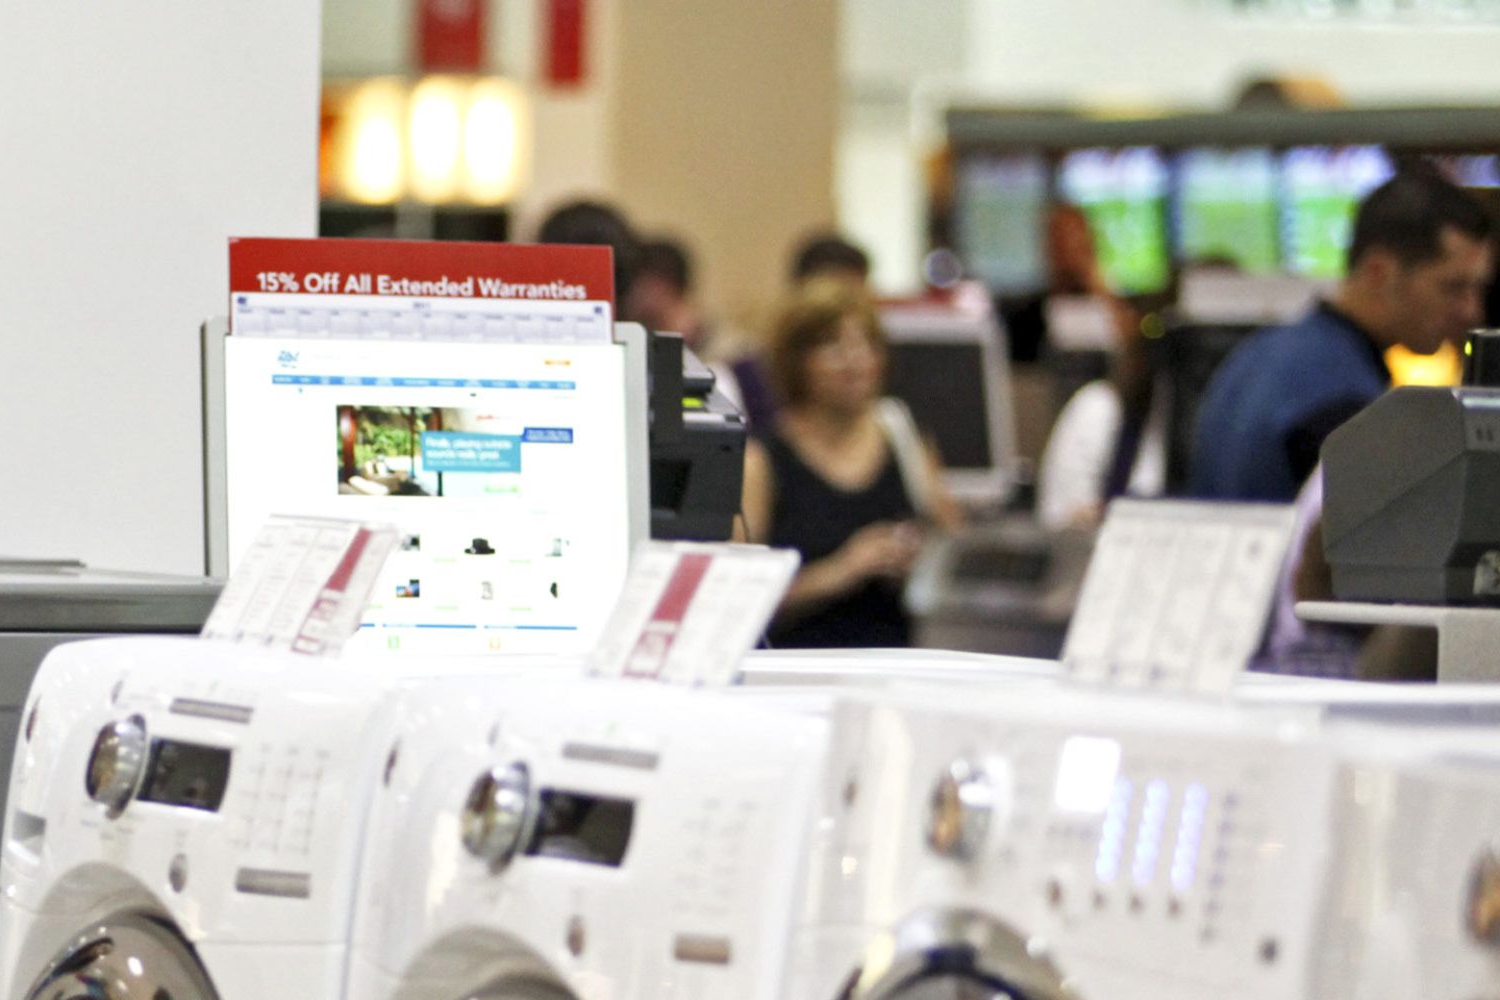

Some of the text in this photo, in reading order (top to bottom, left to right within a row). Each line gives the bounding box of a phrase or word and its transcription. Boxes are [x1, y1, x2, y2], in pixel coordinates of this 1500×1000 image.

[257, 272, 587, 300] 15% Off All Extended Warranties
